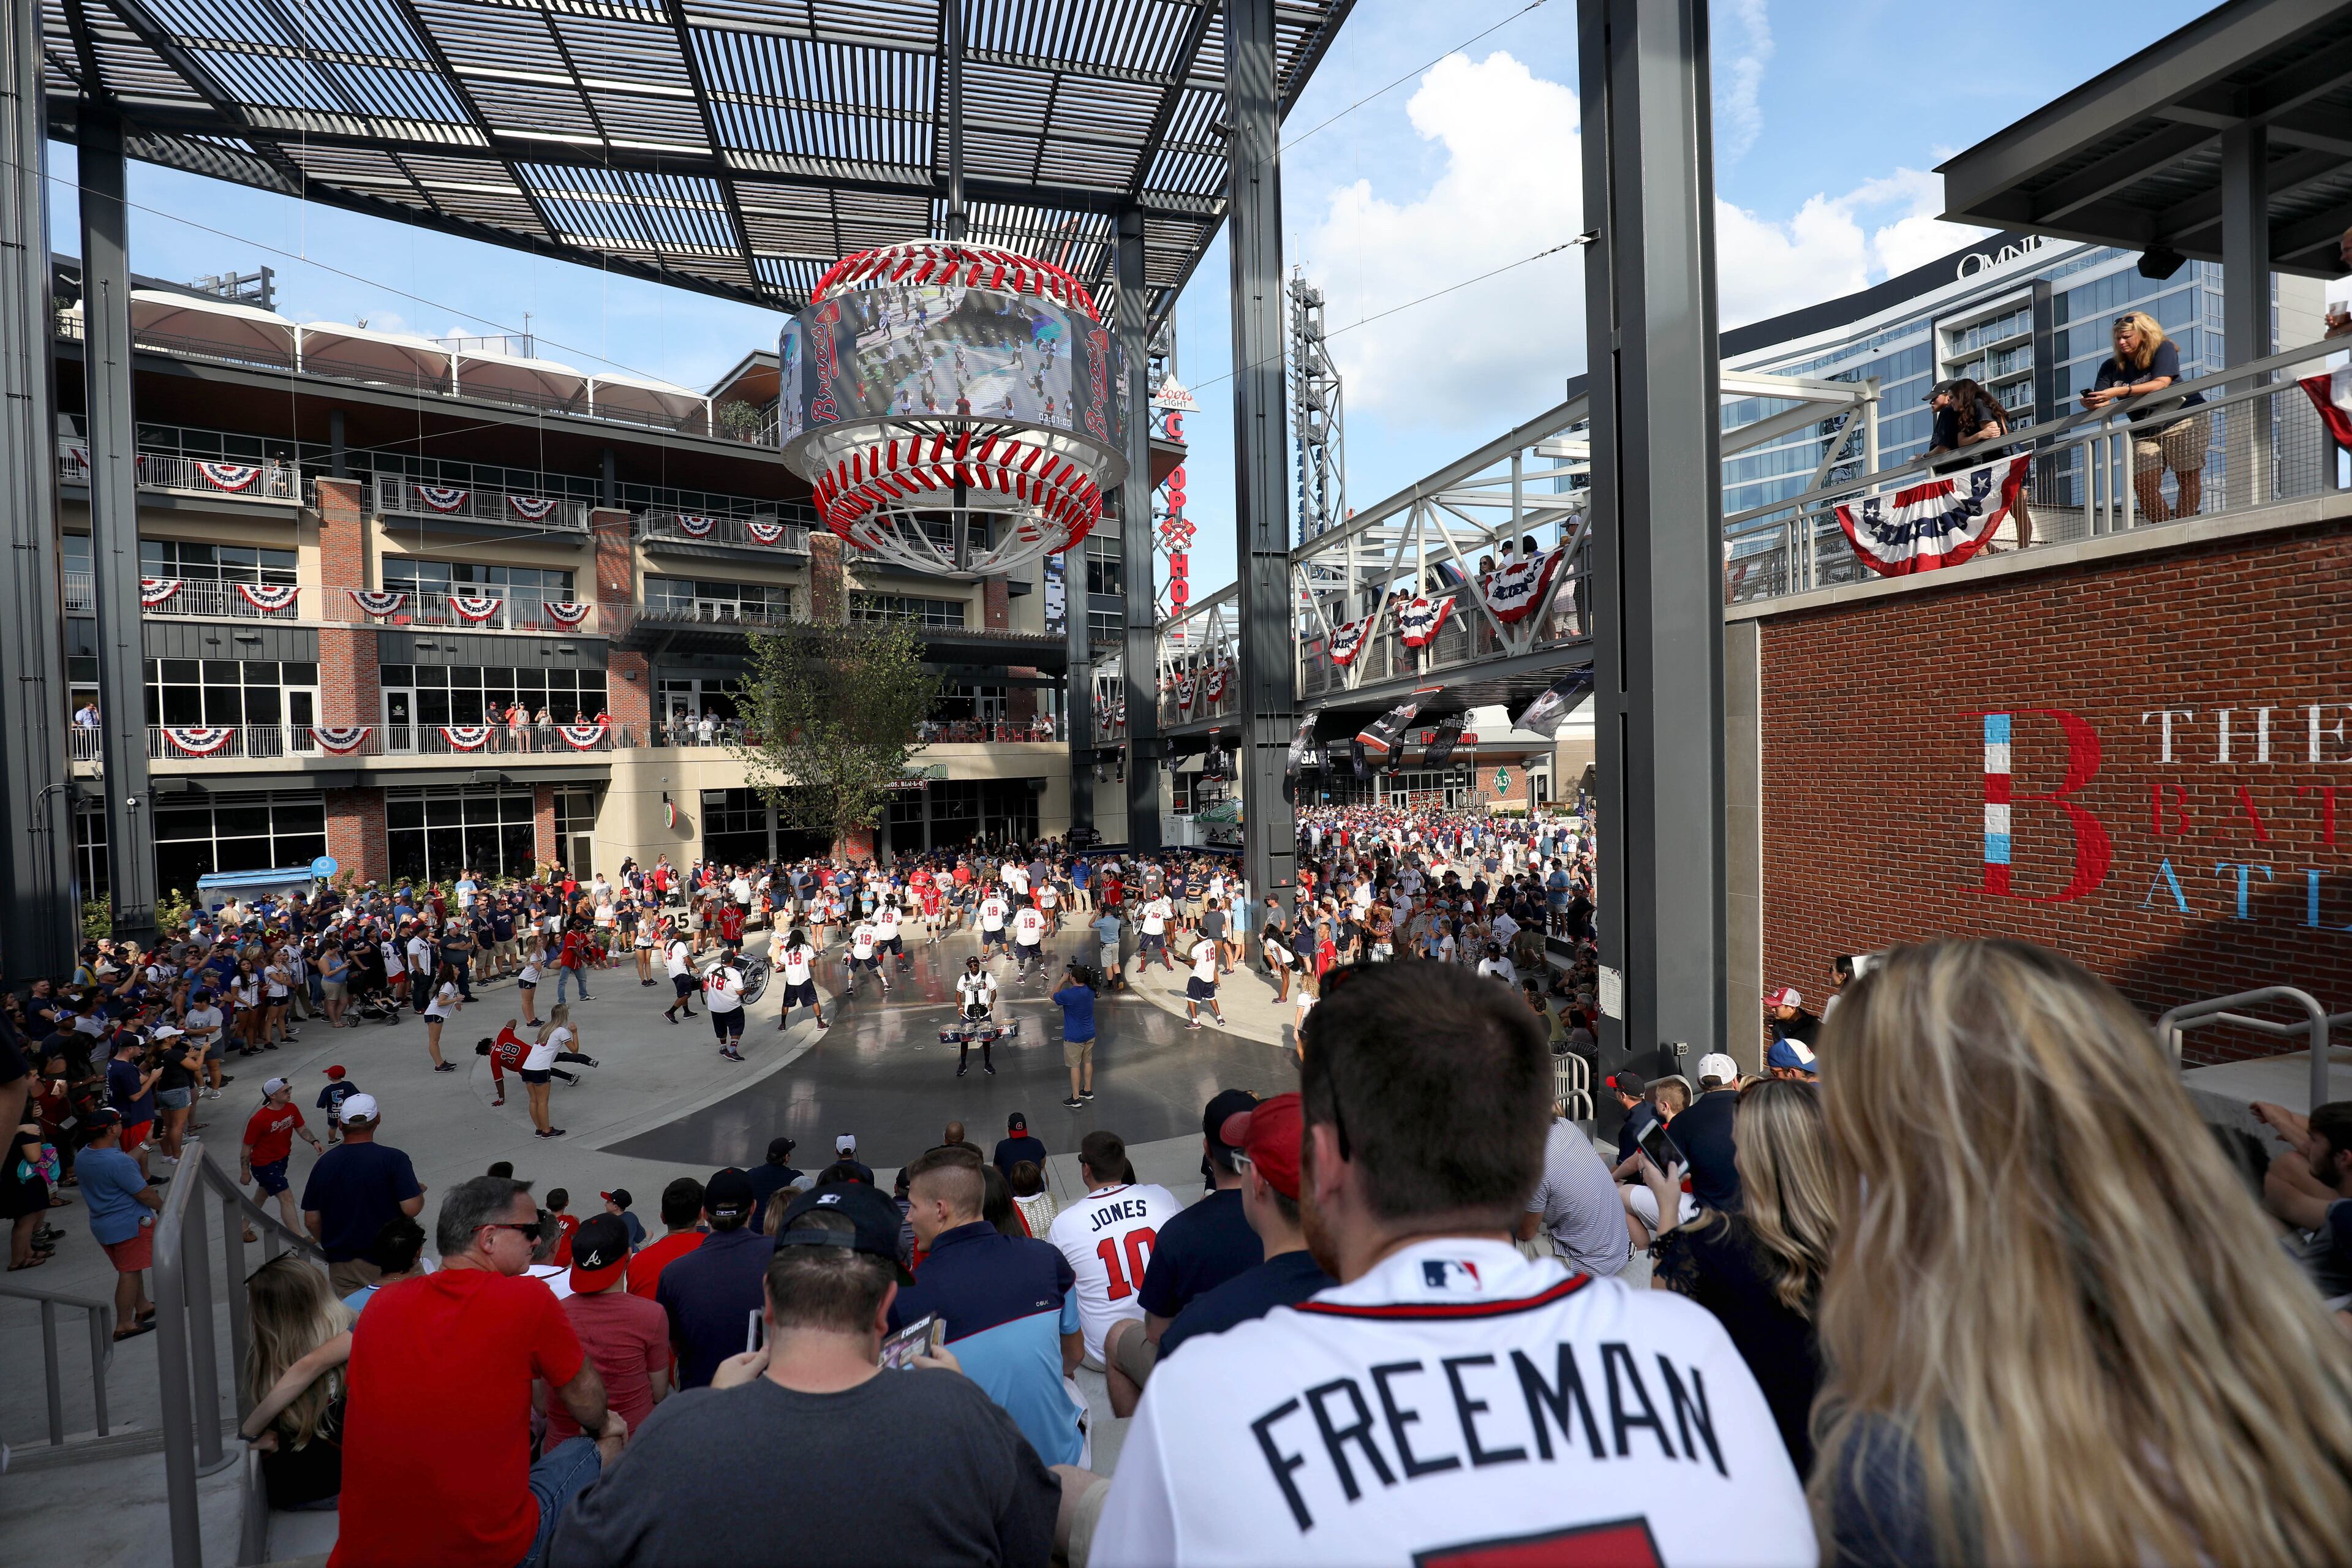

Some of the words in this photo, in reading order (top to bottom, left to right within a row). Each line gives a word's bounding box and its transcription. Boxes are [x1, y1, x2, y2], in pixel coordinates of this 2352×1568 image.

[1957, 235, 2036, 280] OMNI
[811, 325, 840, 423] Braves
[1085, 339, 1109, 443] Braves
[1157, 383, 1194, 401] Coors
[1164, 399, 1187, 408] LIGHT
[1166, 412, 1186, 514] COP
[2143, 705, 2352, 764] THE
[1958, 708, 2111, 902] B
[987, 906, 998, 916] 18
[1023, 917, 1035, 929] 18
[860, 933, 872, 945] 18
[788, 952, 802, 965] 18
[1205, 947, 1215, 962] 18
[711, 974, 725, 991] 18
[500, 1042, 521, 1064] 18
[331, 1089, 344, 1112] 5
[1090, 1207, 1147, 1232] JONES
[1096, 1226, 1156, 1301] 10
[1251, 1341, 1729, 1532] FREEMAN
